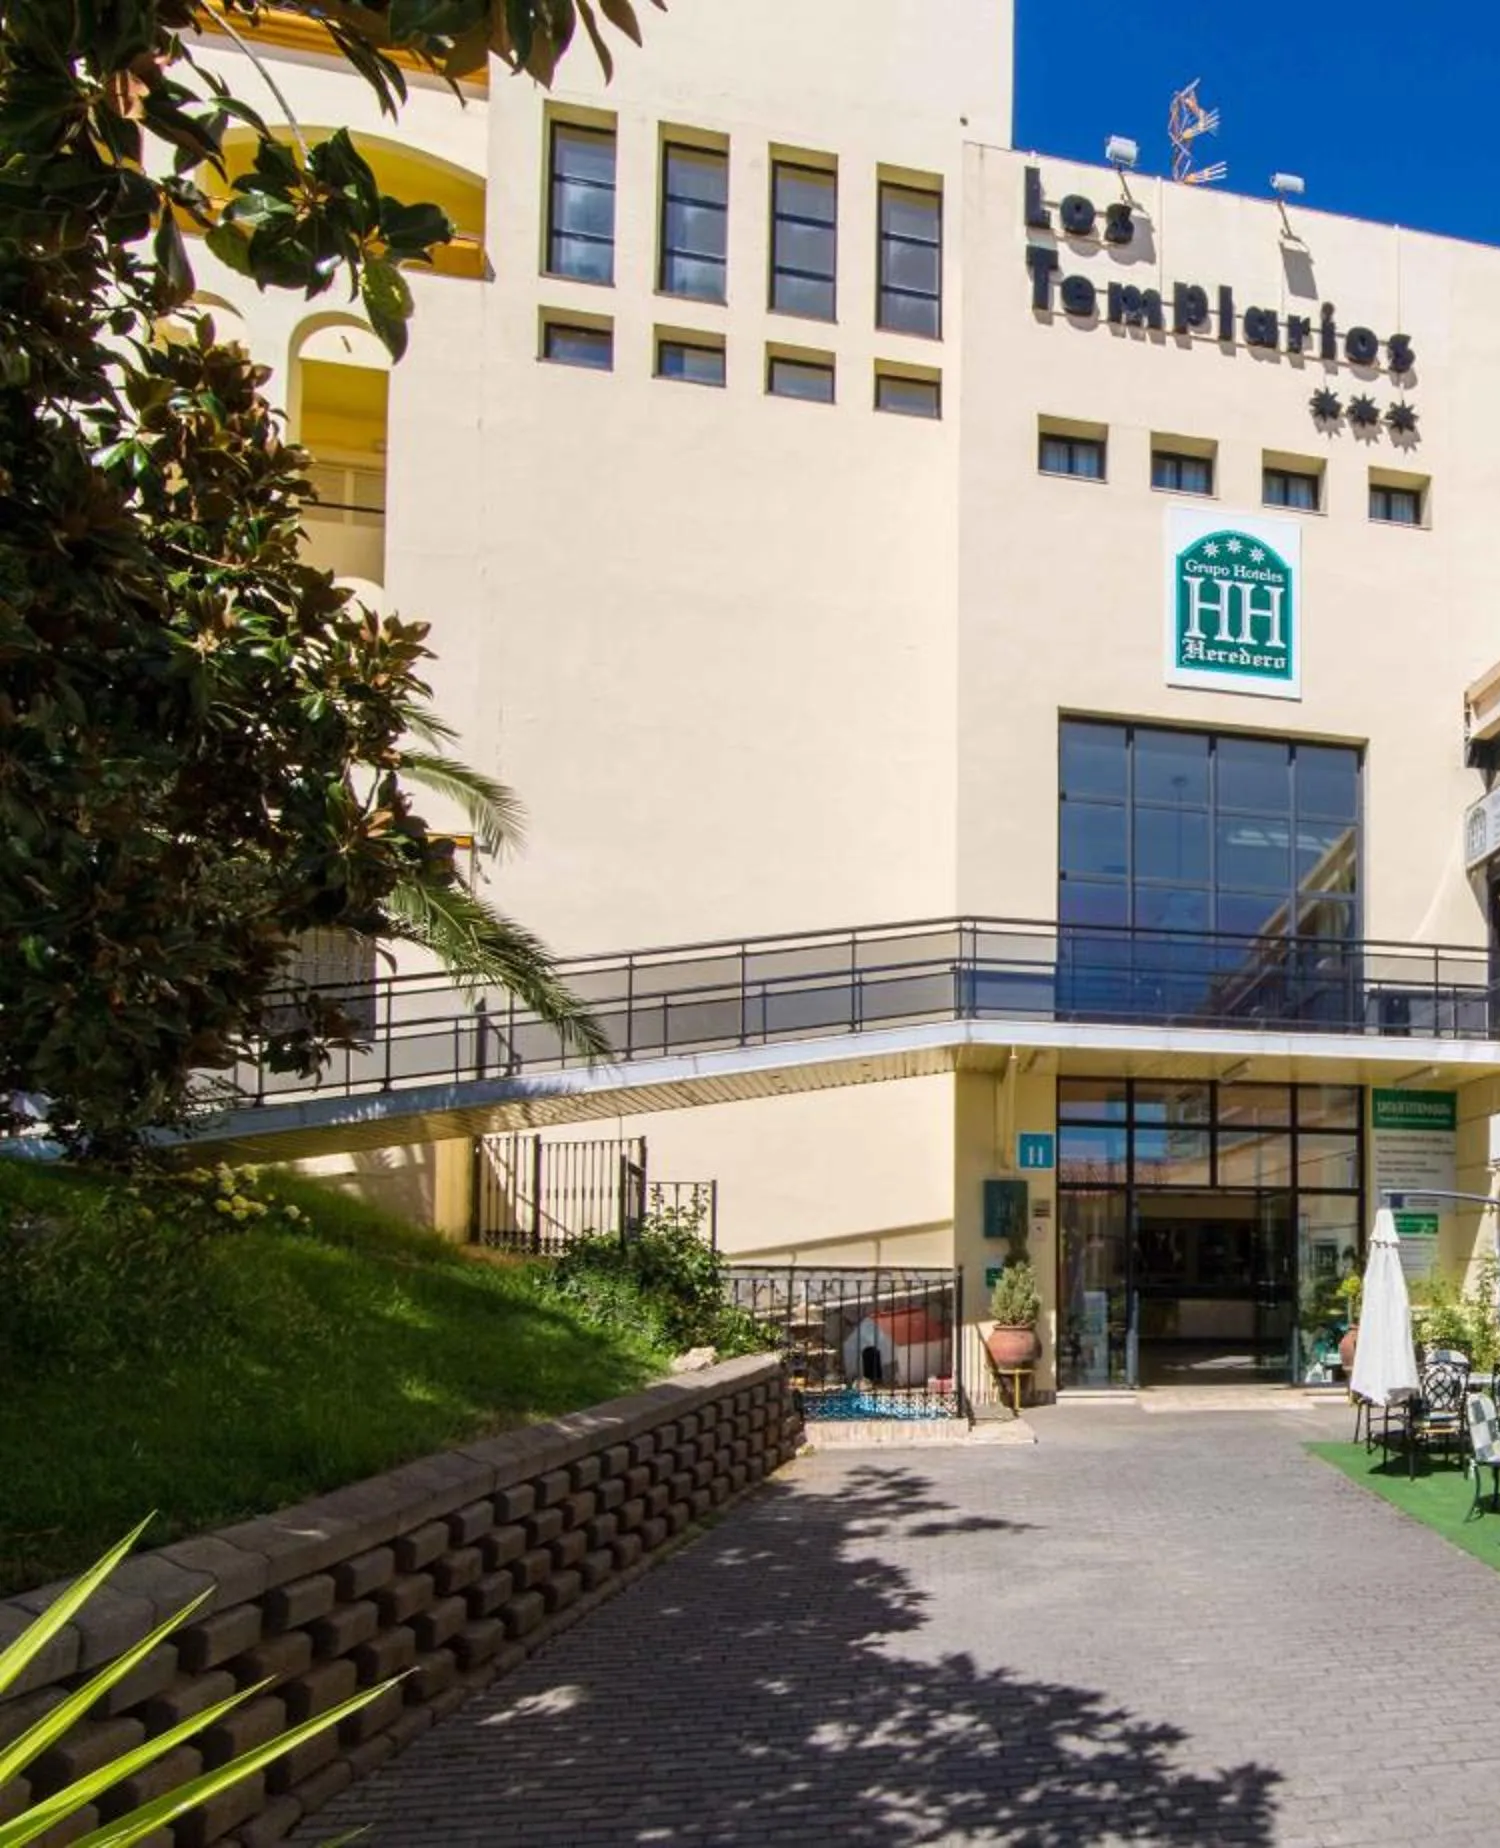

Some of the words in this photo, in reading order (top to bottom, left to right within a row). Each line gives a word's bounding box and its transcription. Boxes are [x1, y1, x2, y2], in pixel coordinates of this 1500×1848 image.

[1024, 166, 1134, 245] Los
[1025, 244, 1416, 373] Templarios
[1185, 560, 1230, 576] Grupo
[1234, 565, 1284, 582] Hoteles
[1184, 577, 1286, 648] HH
[1182, 639, 1286, 668] Heredero
